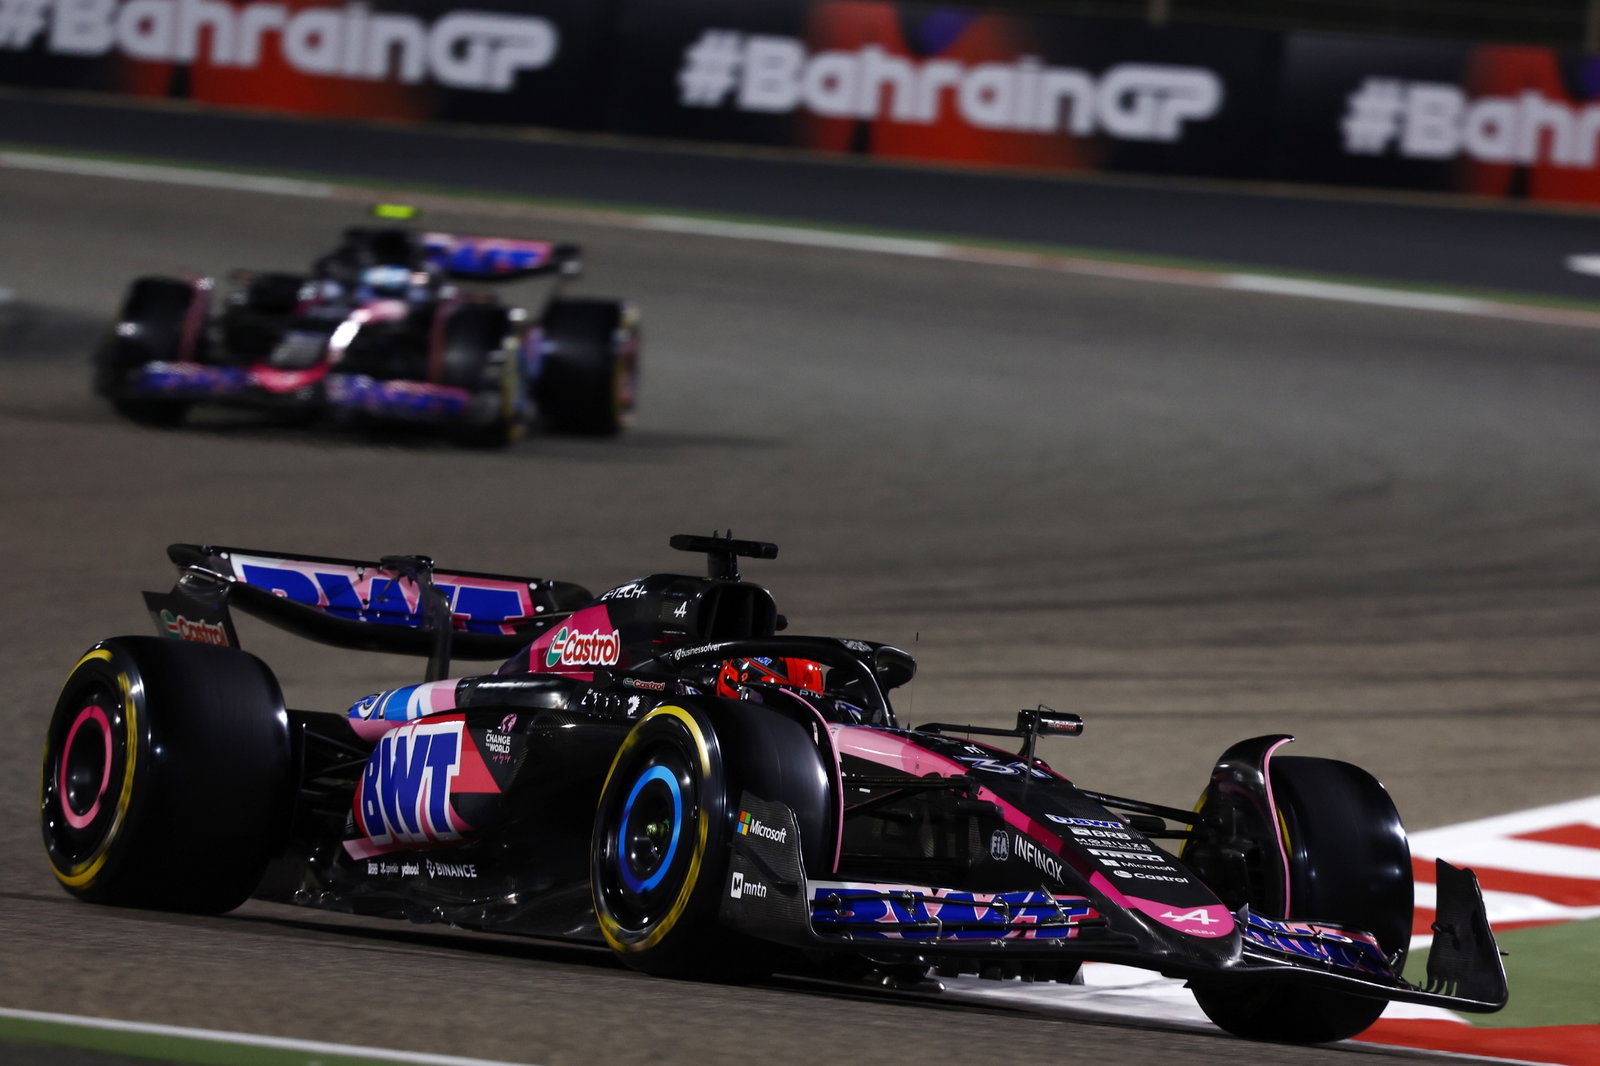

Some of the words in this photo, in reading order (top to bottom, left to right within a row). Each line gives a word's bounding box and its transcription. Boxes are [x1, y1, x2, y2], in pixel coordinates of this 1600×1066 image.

[679, 28, 1222, 141] #BahrainGP
[564, 628, 621, 667] Castrol
[681, 642, 722, 658] businessolver
[633, 677, 666, 691] Castrol
[485, 733, 512, 745] CHANGE
[489, 744, 510, 754] WORLD
[360, 729, 461, 839] BWT
[749, 820, 787, 844] Microsoft
[1014, 834, 1066, 886] INFINOX
[1120, 861, 1178, 873] Microsoft
[435, 861, 478, 878] BINANCE
[1134, 872, 1190, 884] Castrol
[743, 881, 768, 899] mntn
